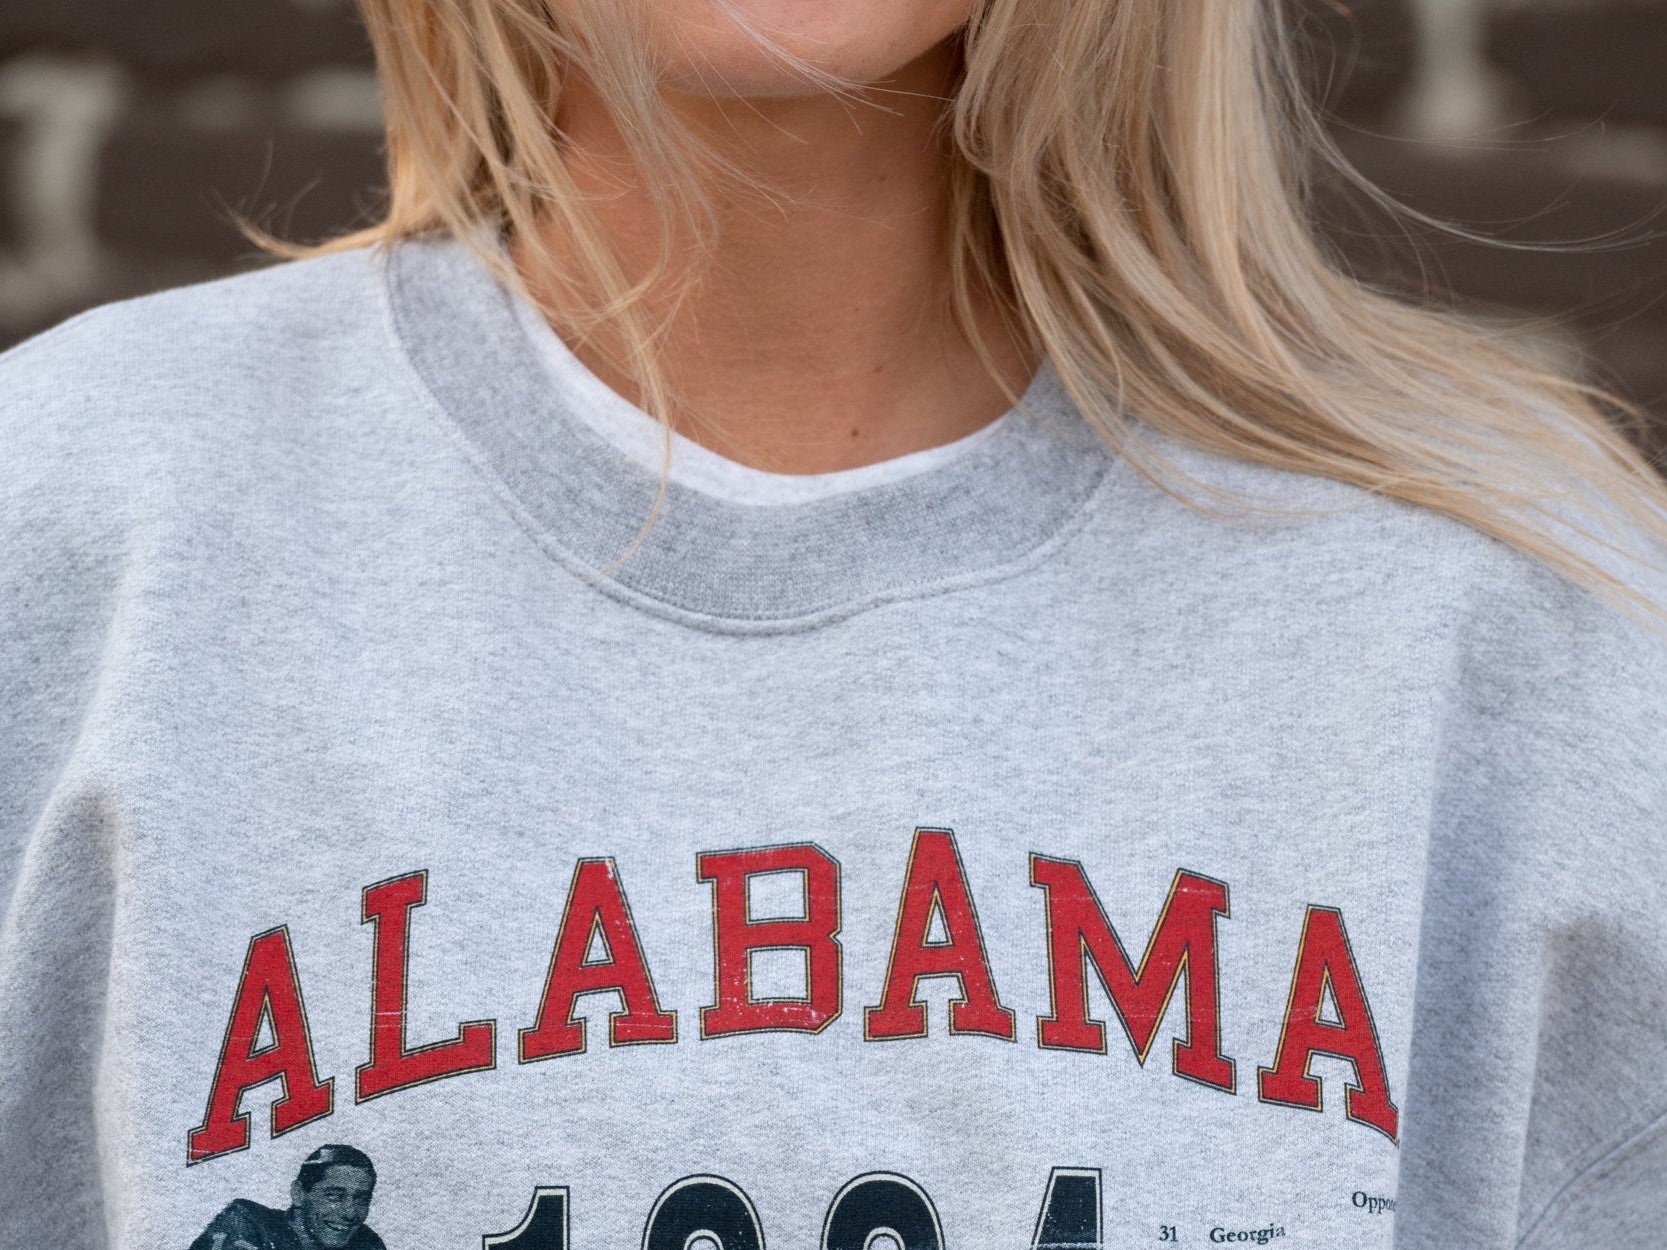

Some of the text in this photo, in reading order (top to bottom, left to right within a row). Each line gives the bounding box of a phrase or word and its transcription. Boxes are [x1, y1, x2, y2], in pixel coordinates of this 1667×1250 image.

[187, 827, 1399, 1165] ALABAMA
[1158, 1223, 1286, 1245] 31 Georgia
